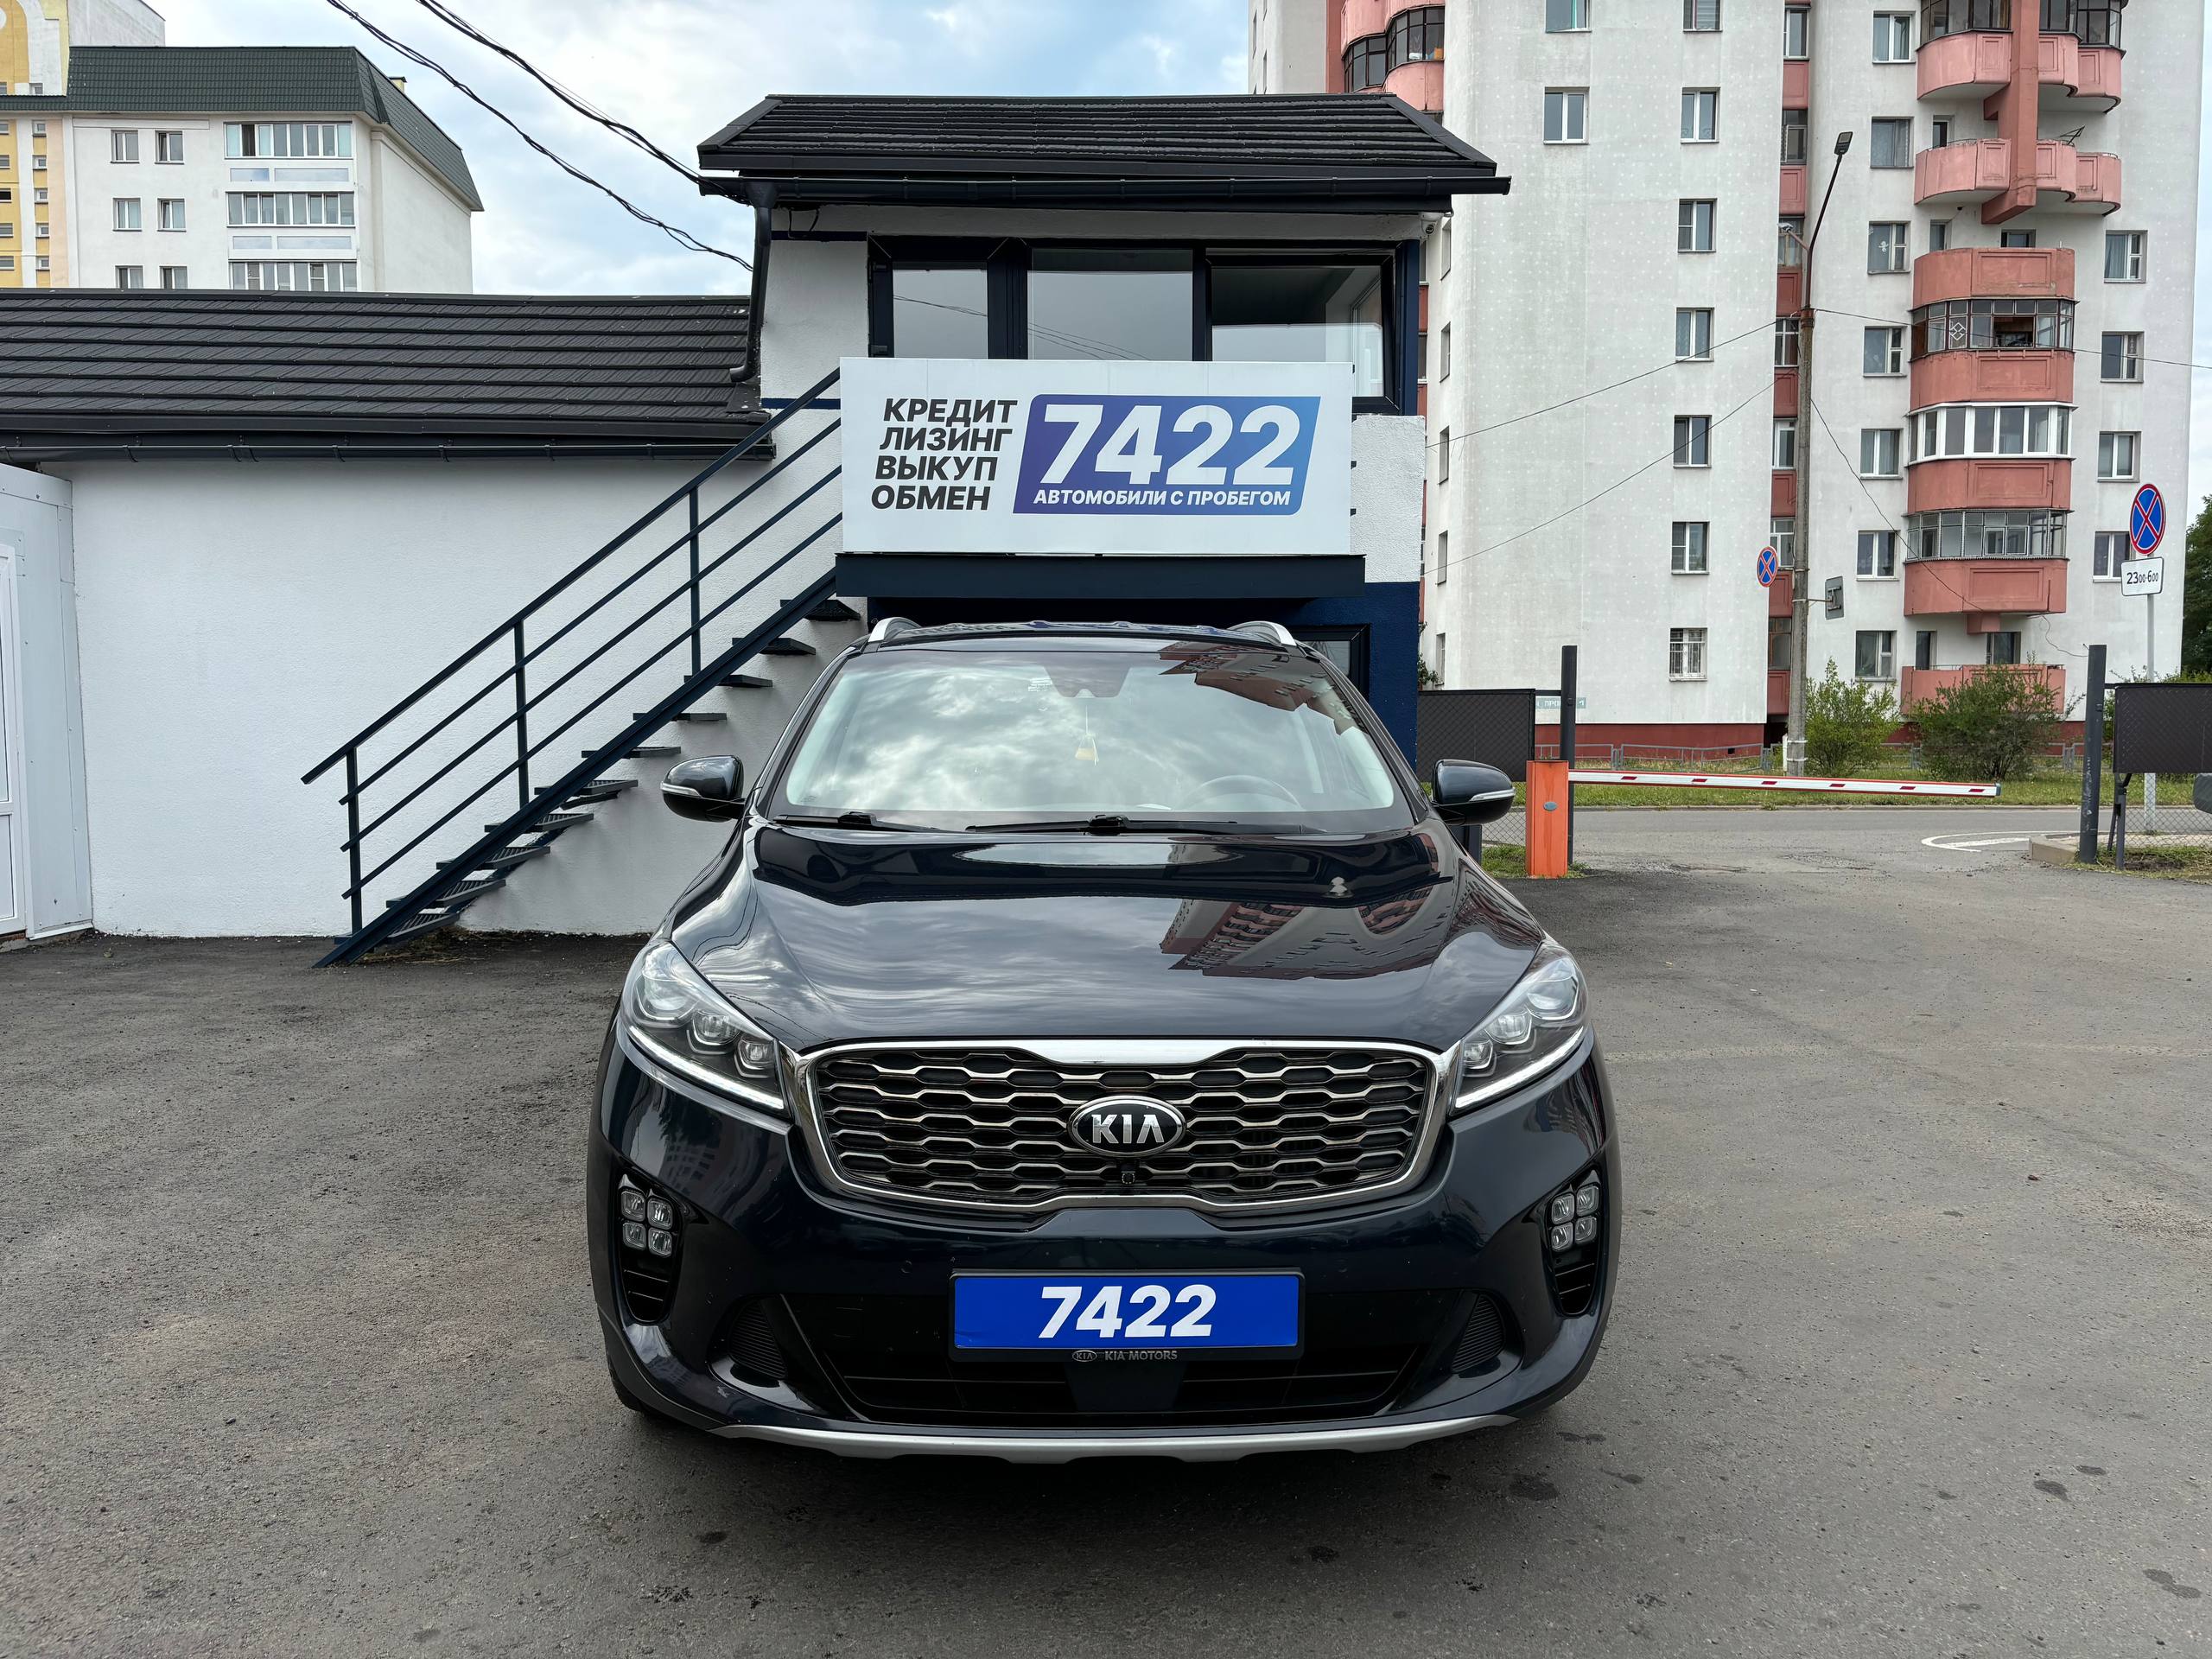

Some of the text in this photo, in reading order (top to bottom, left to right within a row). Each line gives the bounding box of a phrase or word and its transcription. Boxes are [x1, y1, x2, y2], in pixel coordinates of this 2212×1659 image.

[883, 397, 1018, 428] КРЕДИТ
[879, 426, 1014, 452] ЛИЗИНГ
[1039, 404, 1300, 485] 7422
[874, 454, 998, 481] ВЫКУП
[871, 484, 991, 511] ОБМЕН
[1033, 488, 1291, 506] АВТОМОБИЛИ С ПРОБЕГОМ
[1091, 1114, 1165, 1144] KIA
[1038, 1284, 1217, 1338] 7422
[1104, 1351, 1126, 1361] KIA
[1128, 1350, 1179, 1361] MOTORS
